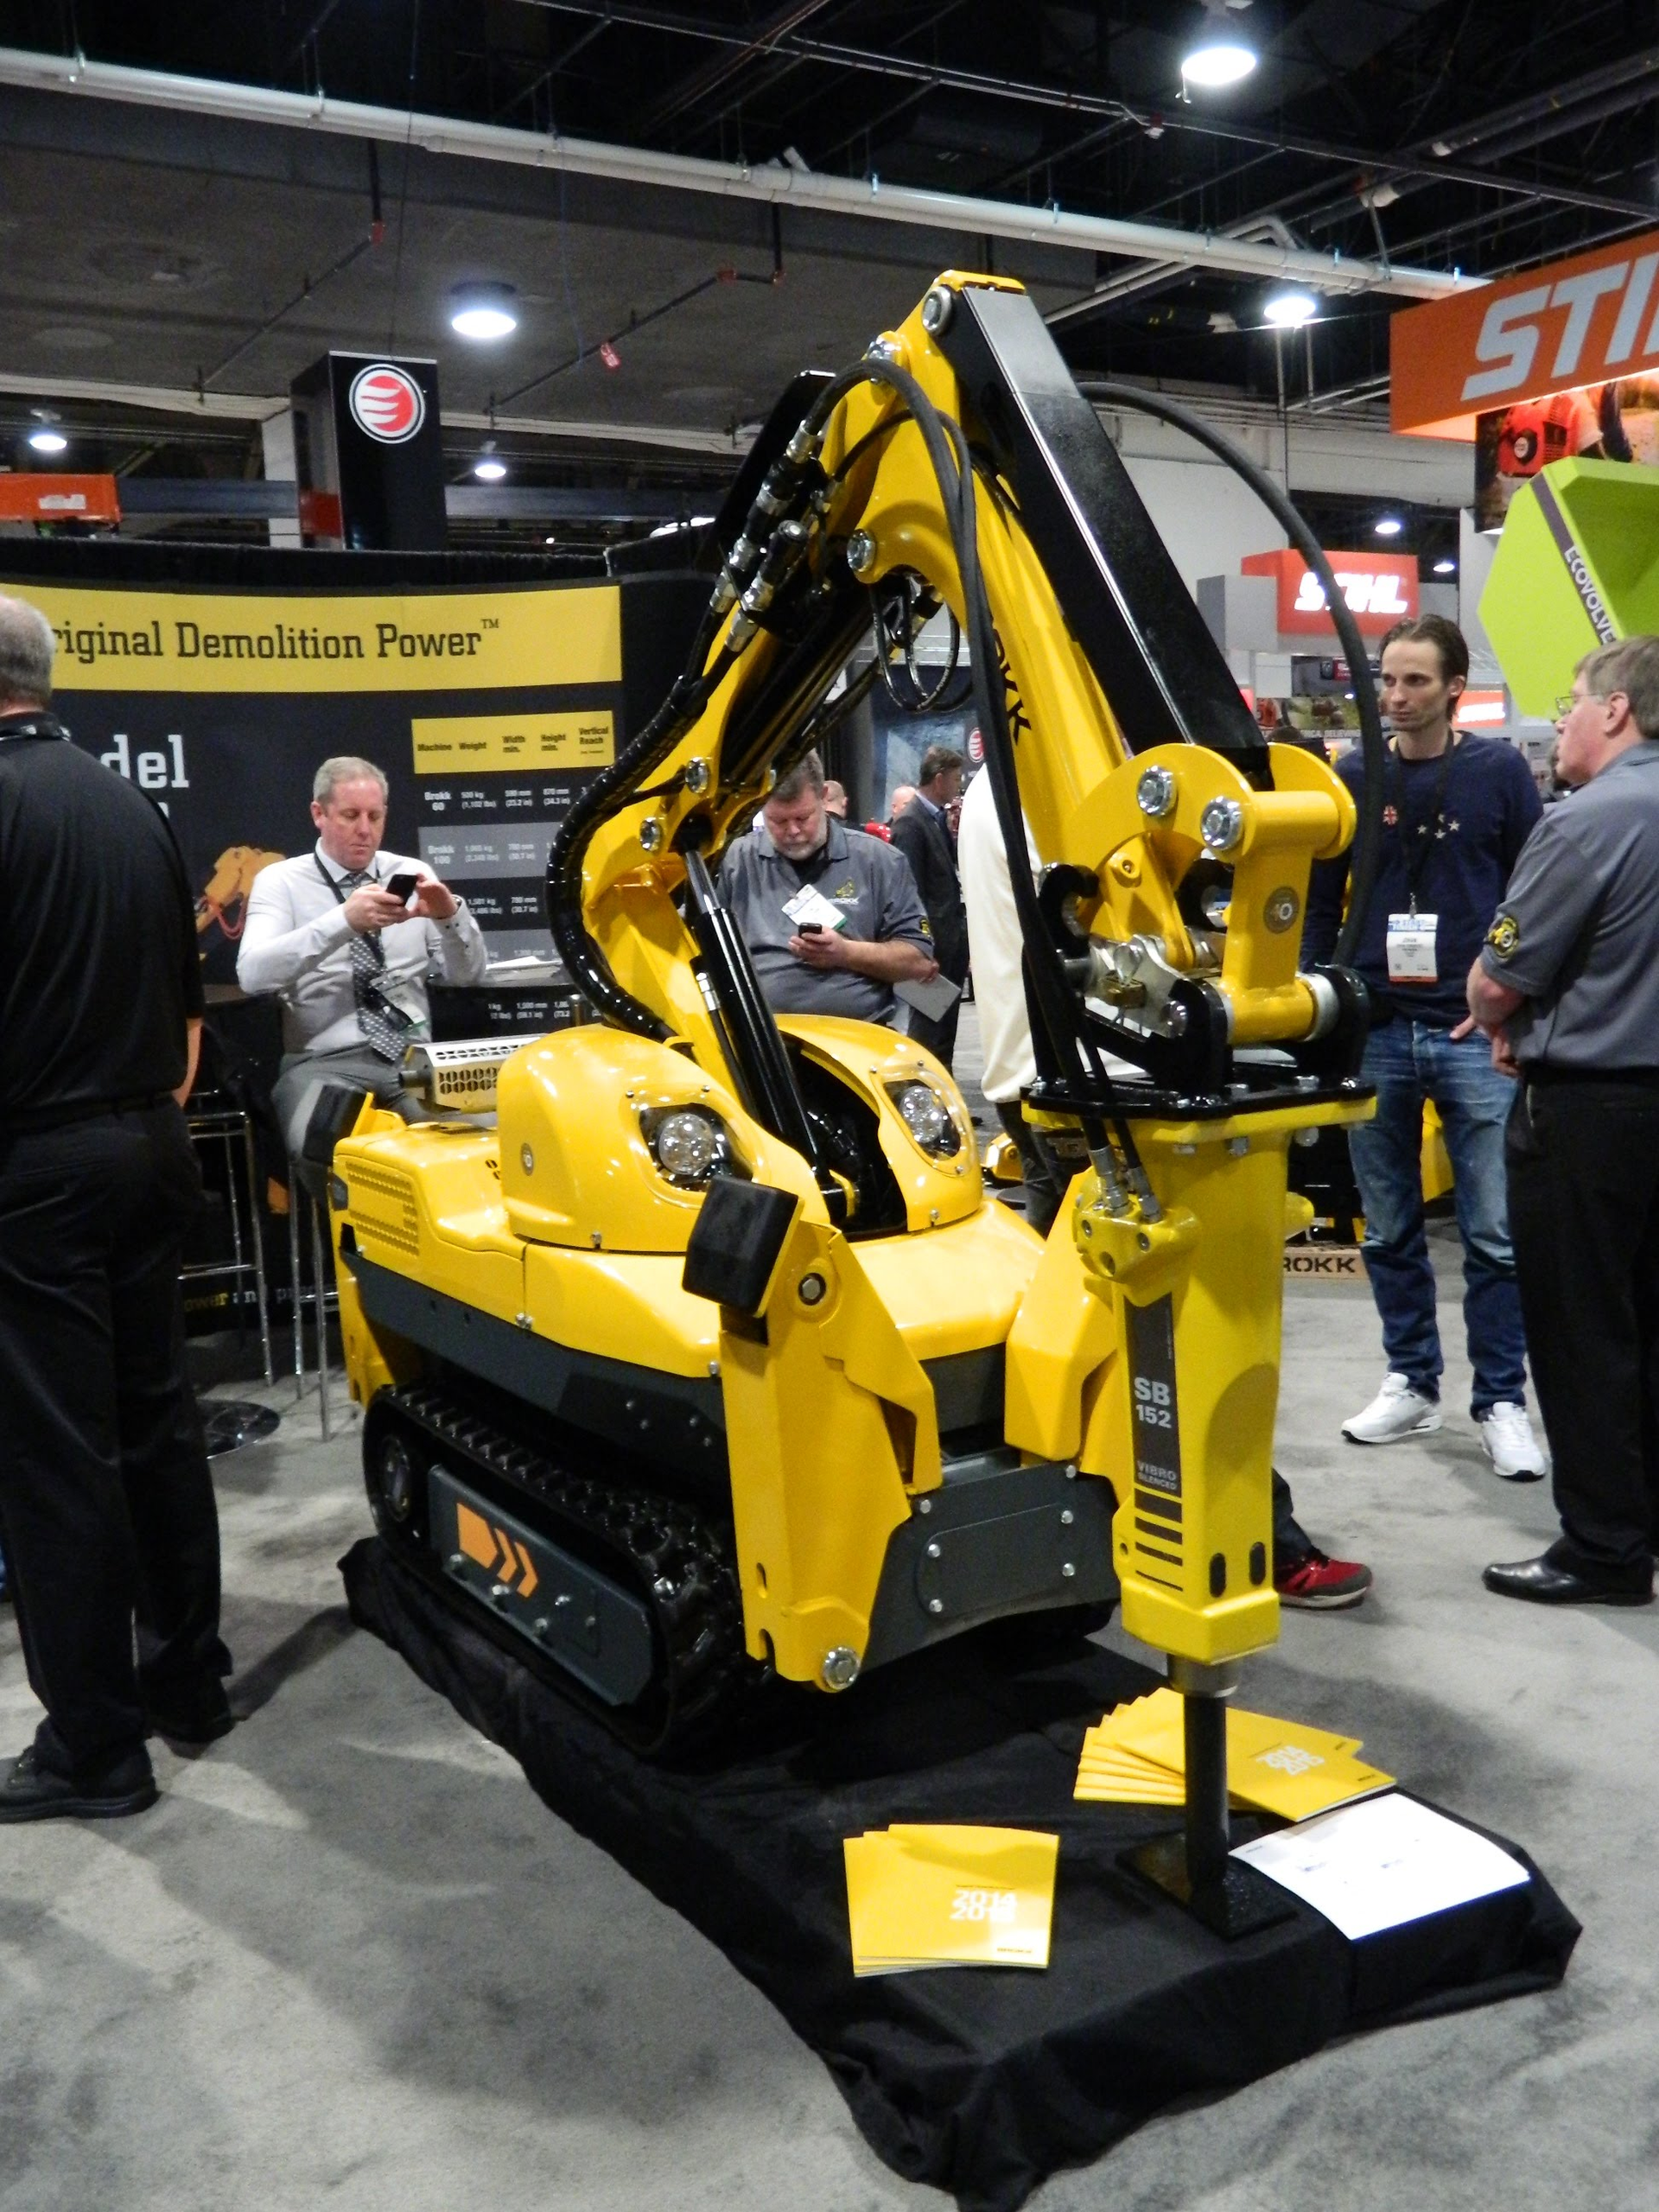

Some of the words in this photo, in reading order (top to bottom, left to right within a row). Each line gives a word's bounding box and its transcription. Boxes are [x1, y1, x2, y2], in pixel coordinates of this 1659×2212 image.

[1564, 544, 1616, 645] ECOVOLVE
[52, 620, 163, 664] riginal
[175, 621, 365, 658] Demolition
[417, 743, 453, 752] Machine
[459, 741, 487, 752] Weight
[541, 734, 566, 743] Height
[579, 736, 604, 745] Reach
[100, 734, 189, 788] del
[424, 791, 452, 800] Brokk
[428, 845, 454, 854] Brokk
[1283, 1257, 1356, 1273] ROKK
[1134, 1376, 1171, 1406] SB
[1135, 1404, 1173, 1428] 152
[1137, 1460, 1176, 1481] VIBRO
[952, 1889, 1017, 1907] 2014
